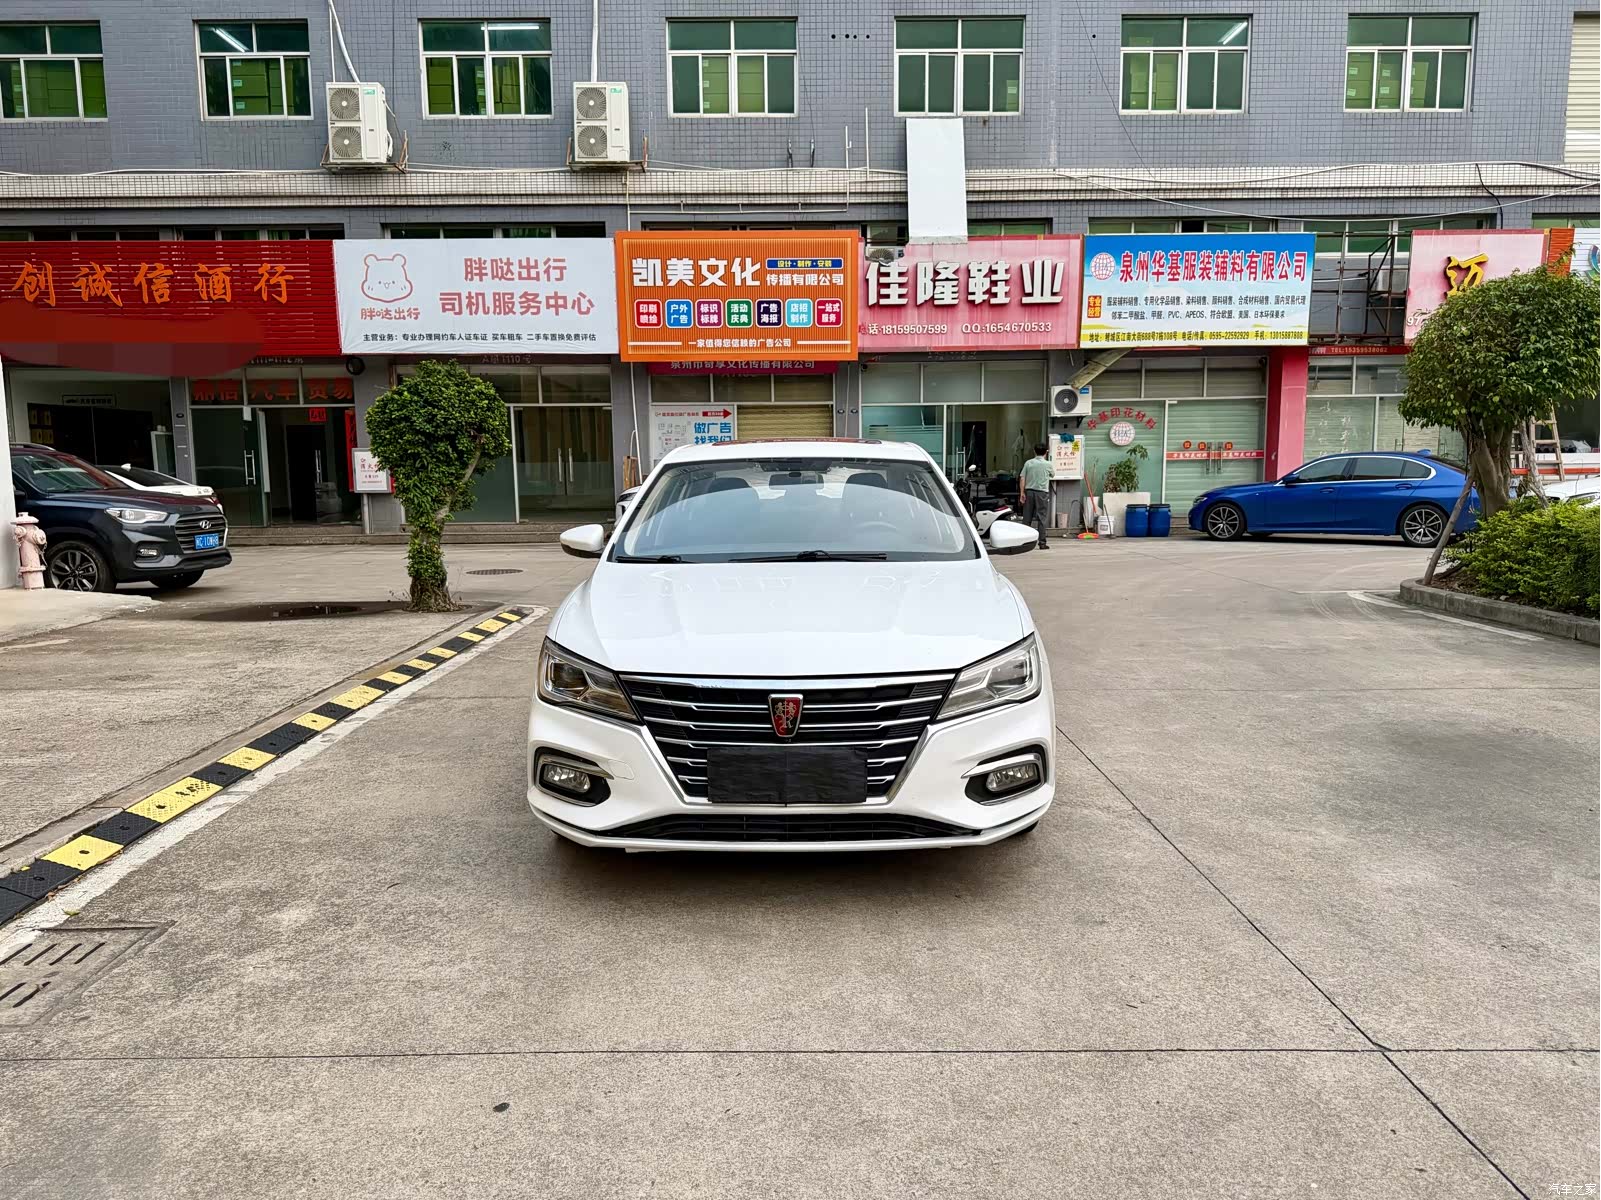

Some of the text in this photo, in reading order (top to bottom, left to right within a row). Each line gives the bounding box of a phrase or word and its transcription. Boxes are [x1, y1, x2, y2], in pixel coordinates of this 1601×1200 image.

[463, 257, 567, 282] 胖哒出行
[1119, 250, 1308, 283] 泉州华基服装辅料有限公司
[632, 257, 761, 287] 凯美文化
[766, 273, 844, 287] 传播有限公司
[865, 260, 1065, 306] 佳隆鞋业
[439, 291, 595, 316] 司机服务中心
[1087, 296, 1101, 306] 专业
[640, 303, 657, 313] 印刷
[670, 303, 688, 313] 户外
[700, 303, 718, 313] 标识
[731, 303, 748, 313] 活动
[760, 303, 778, 313] 广告
[790, 303, 808, 313] 店招
[817, 303, 840, 313] 一站式
[360, 307, 420, 321] 胖哒出行
[640, 314, 657, 324] 喷绘
[670, 314, 688, 324] 广告
[700, 314, 718, 324] 标牌
[731, 314, 748, 324] 庆典
[760, 314, 778, 324] 海报
[790, 314, 808, 324] 制作
[821, 314, 837, 324] 服务
[962, 322, 1052, 334] QQ:1654670533
[492, 333, 523, 341] 买车租车
[526, 332, 597, 341] 二手车置换免费评估
[688, 338, 792, 348] 一家值得您信赖的广告公司
[694, 422, 732, 434] 做广告
[694, 435, 732, 445] 找我们
